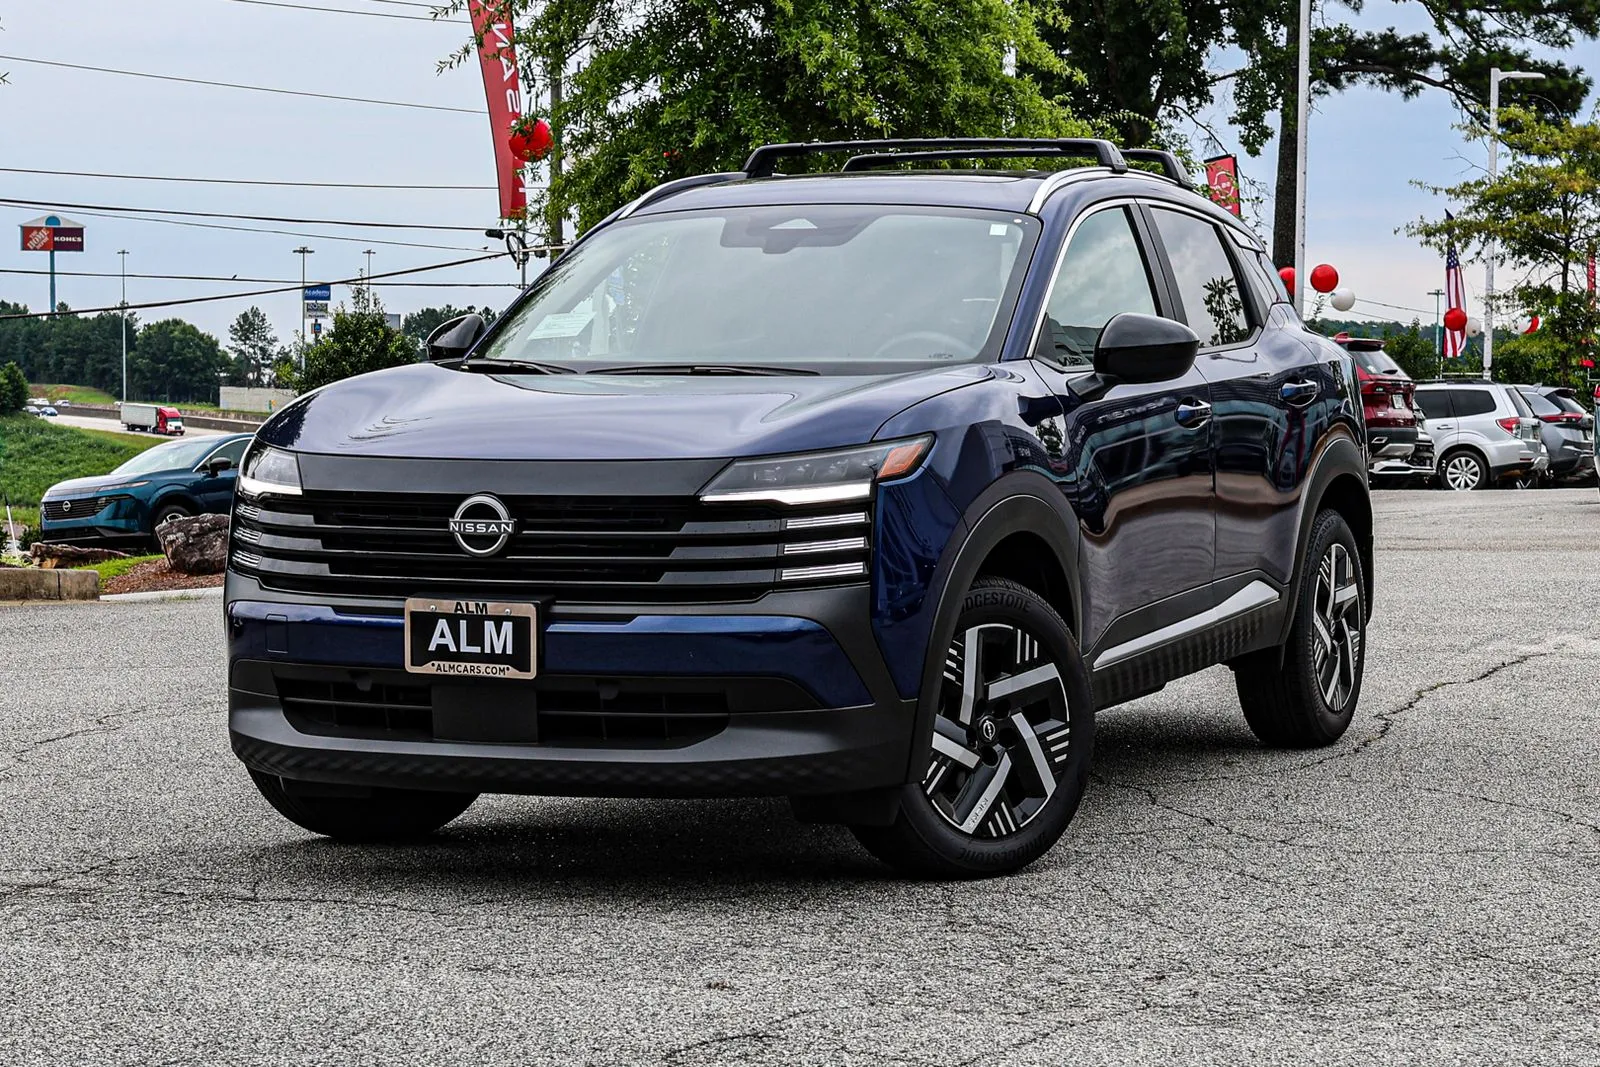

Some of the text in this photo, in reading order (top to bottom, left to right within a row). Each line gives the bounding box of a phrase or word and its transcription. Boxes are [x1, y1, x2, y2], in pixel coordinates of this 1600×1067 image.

[27, 227, 49, 250] HOME
[449, 521, 512, 533] NISSAN
[454, 602, 488, 615] ALM
[428, 618, 513, 655] ALM
[435, 663, 506, 676] ALMCARS.COM
